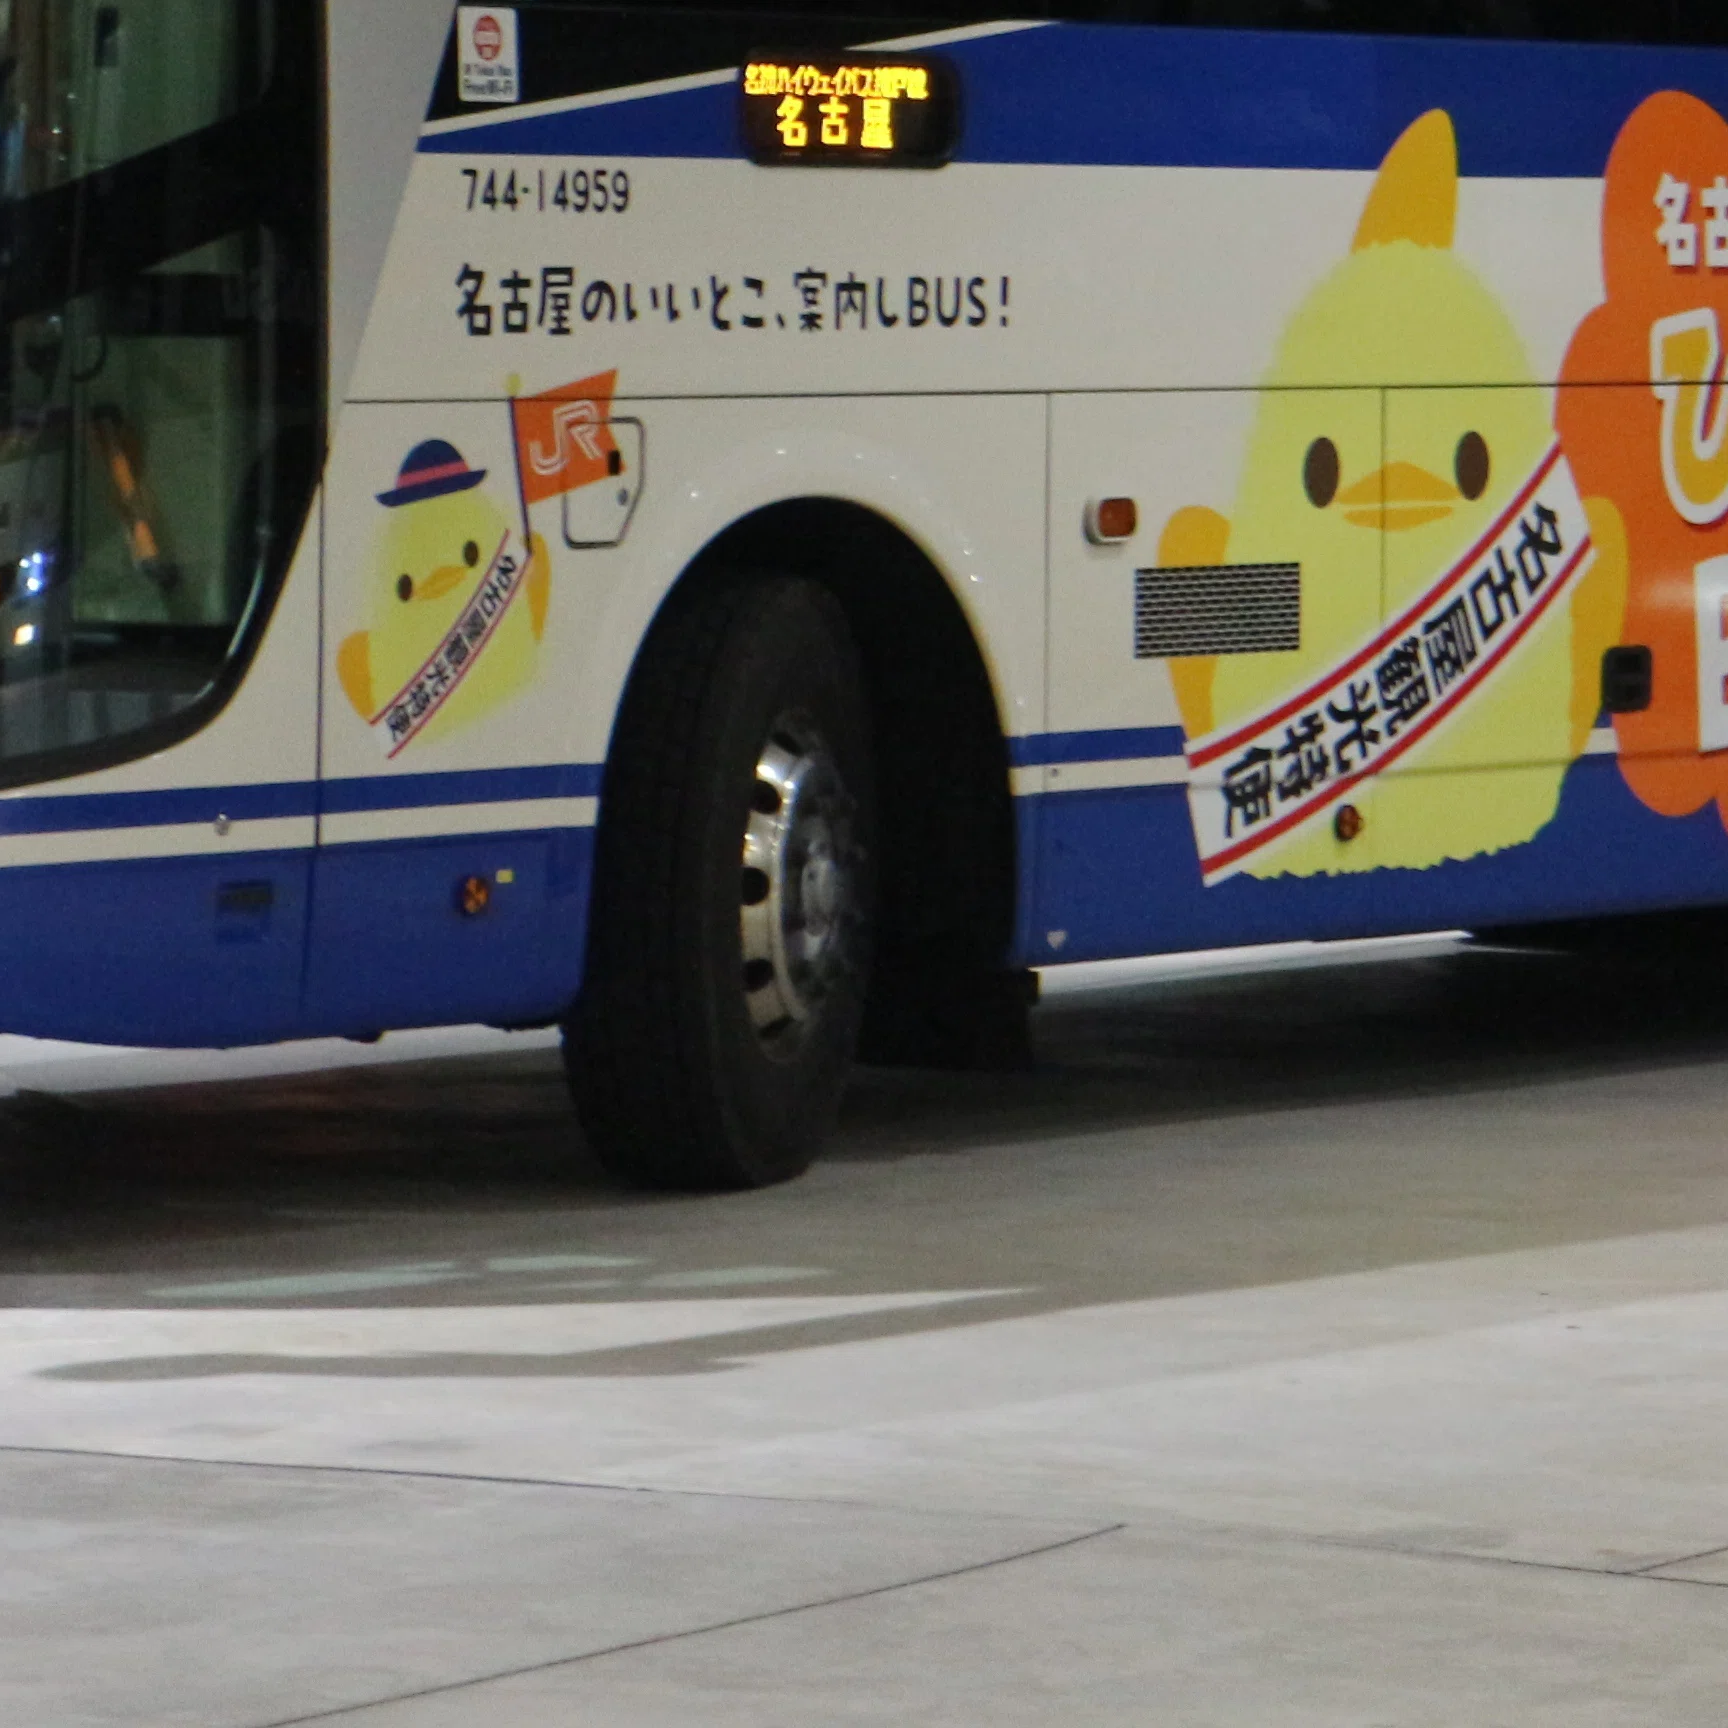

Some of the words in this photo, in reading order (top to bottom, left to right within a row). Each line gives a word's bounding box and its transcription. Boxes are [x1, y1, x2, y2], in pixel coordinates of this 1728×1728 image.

[776, 95, 893, 149] 名古屋
[462, 170, 630, 213] 744-14959
[529, 399, 601, 476] JR
[1223, 502, 1562, 838] 名古屋観光特使
